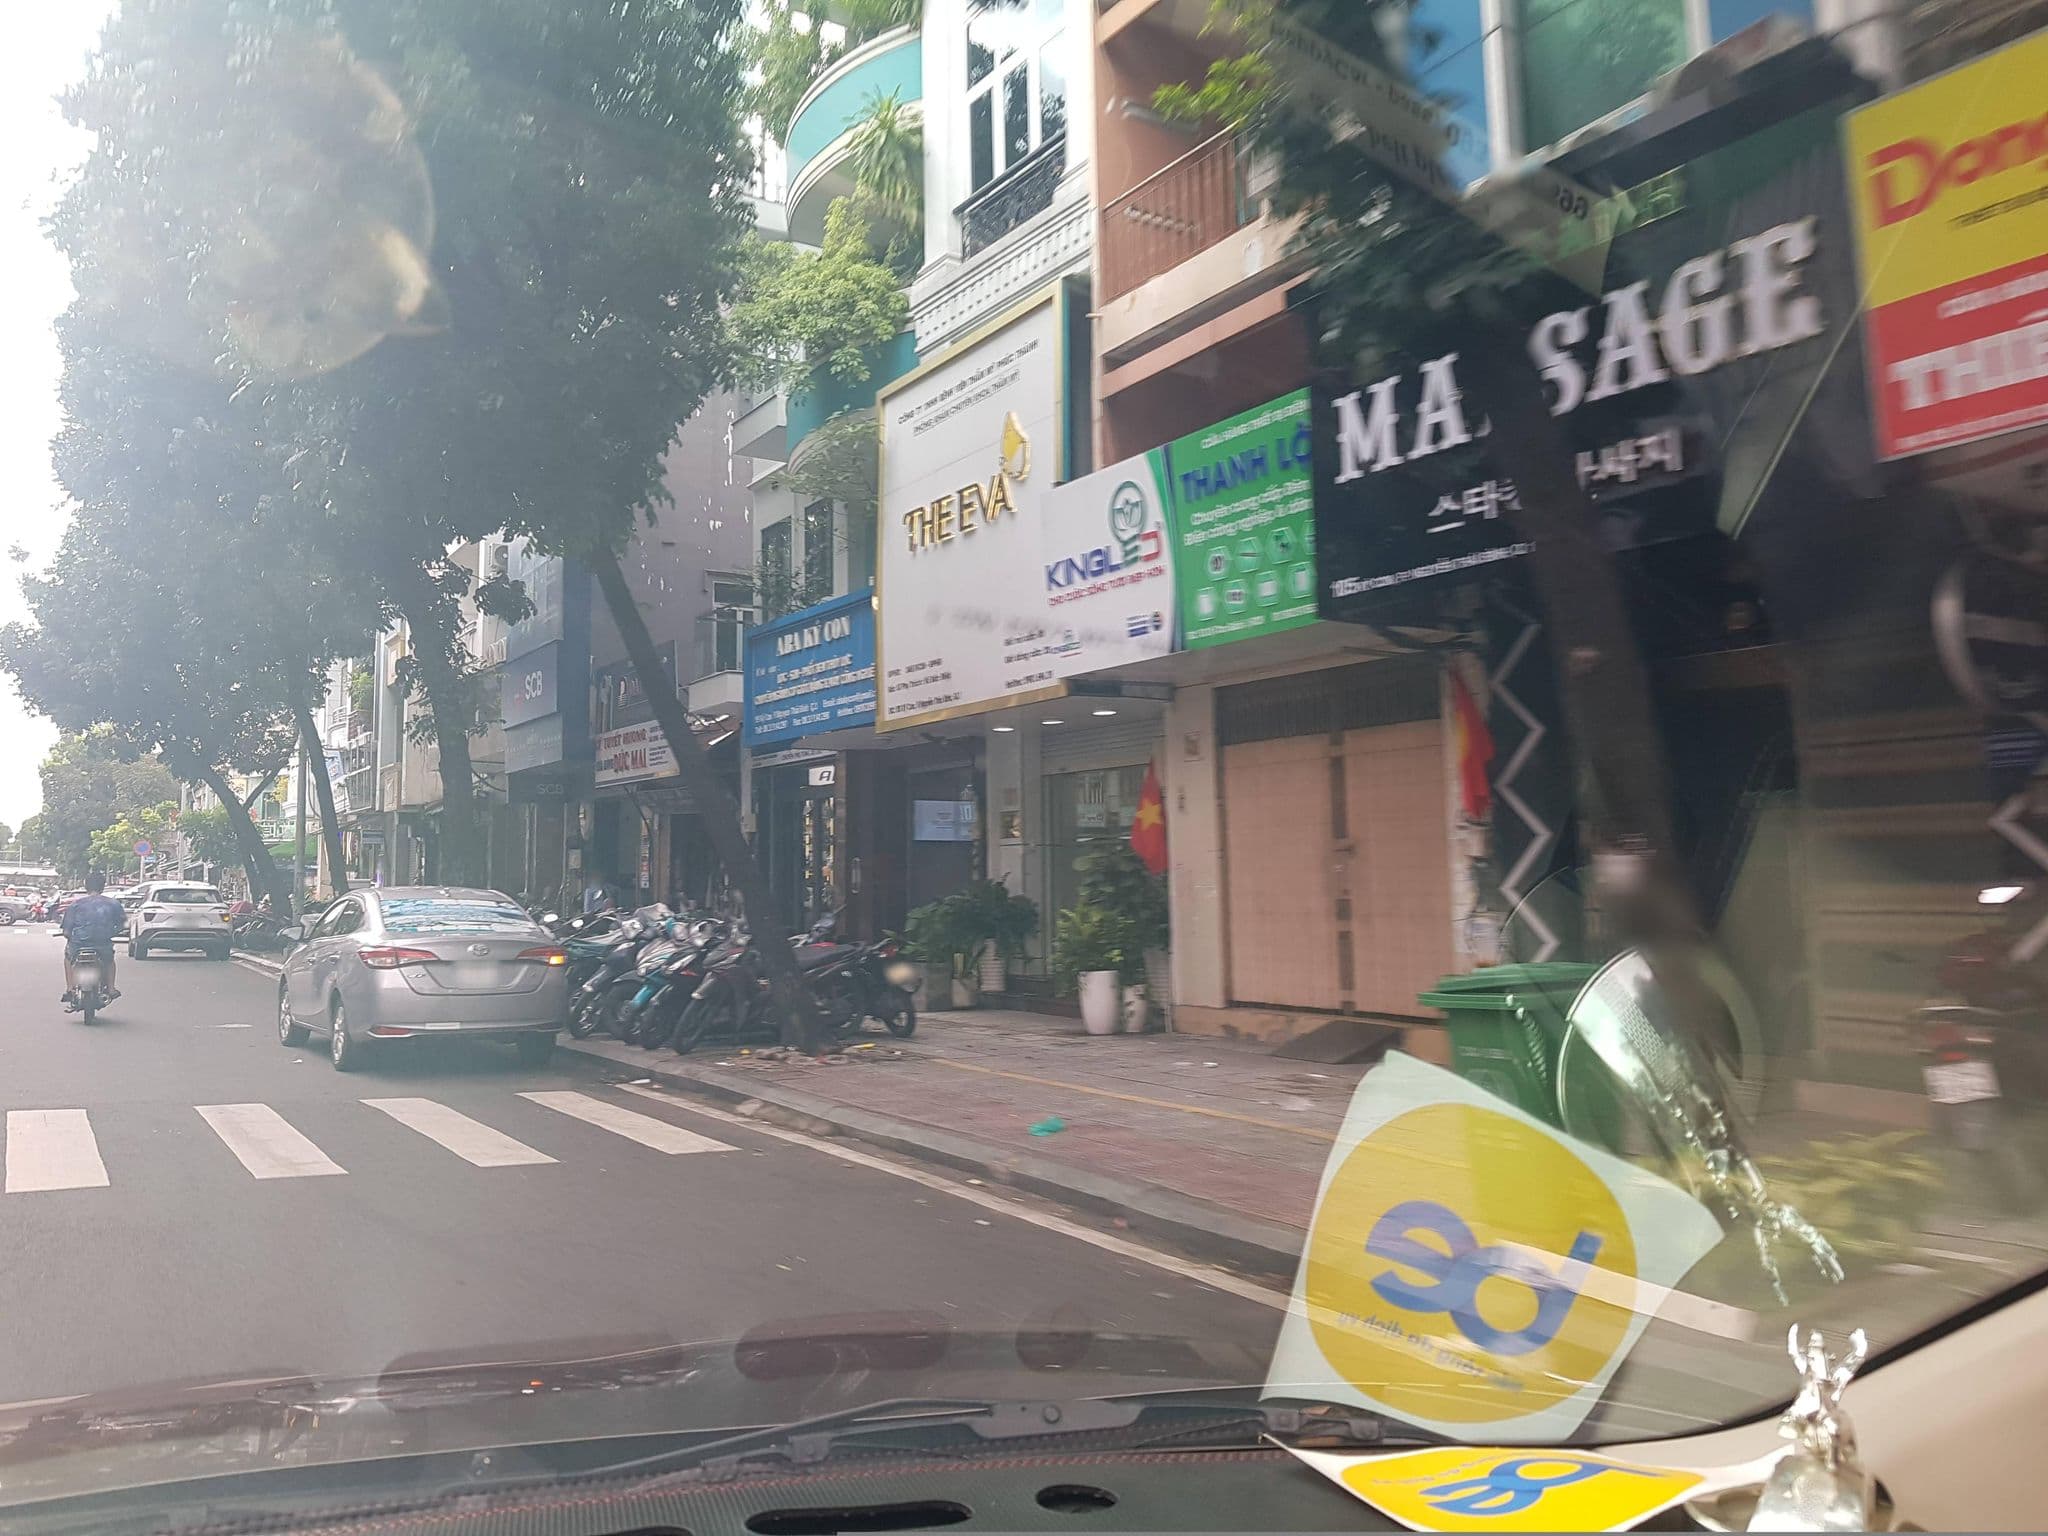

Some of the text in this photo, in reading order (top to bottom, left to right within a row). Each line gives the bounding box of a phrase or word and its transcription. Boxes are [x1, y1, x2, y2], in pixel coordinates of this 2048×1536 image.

[1332, 214, 1826, 486] MASAGE
[1181, 443, 1269, 504] THANH
[903, 473, 1018, 552] THE EVA
[1044, 530, 1163, 591] KINGLED
[524, 670, 543, 701] SCB
[536, 783, 564, 795] SCB
